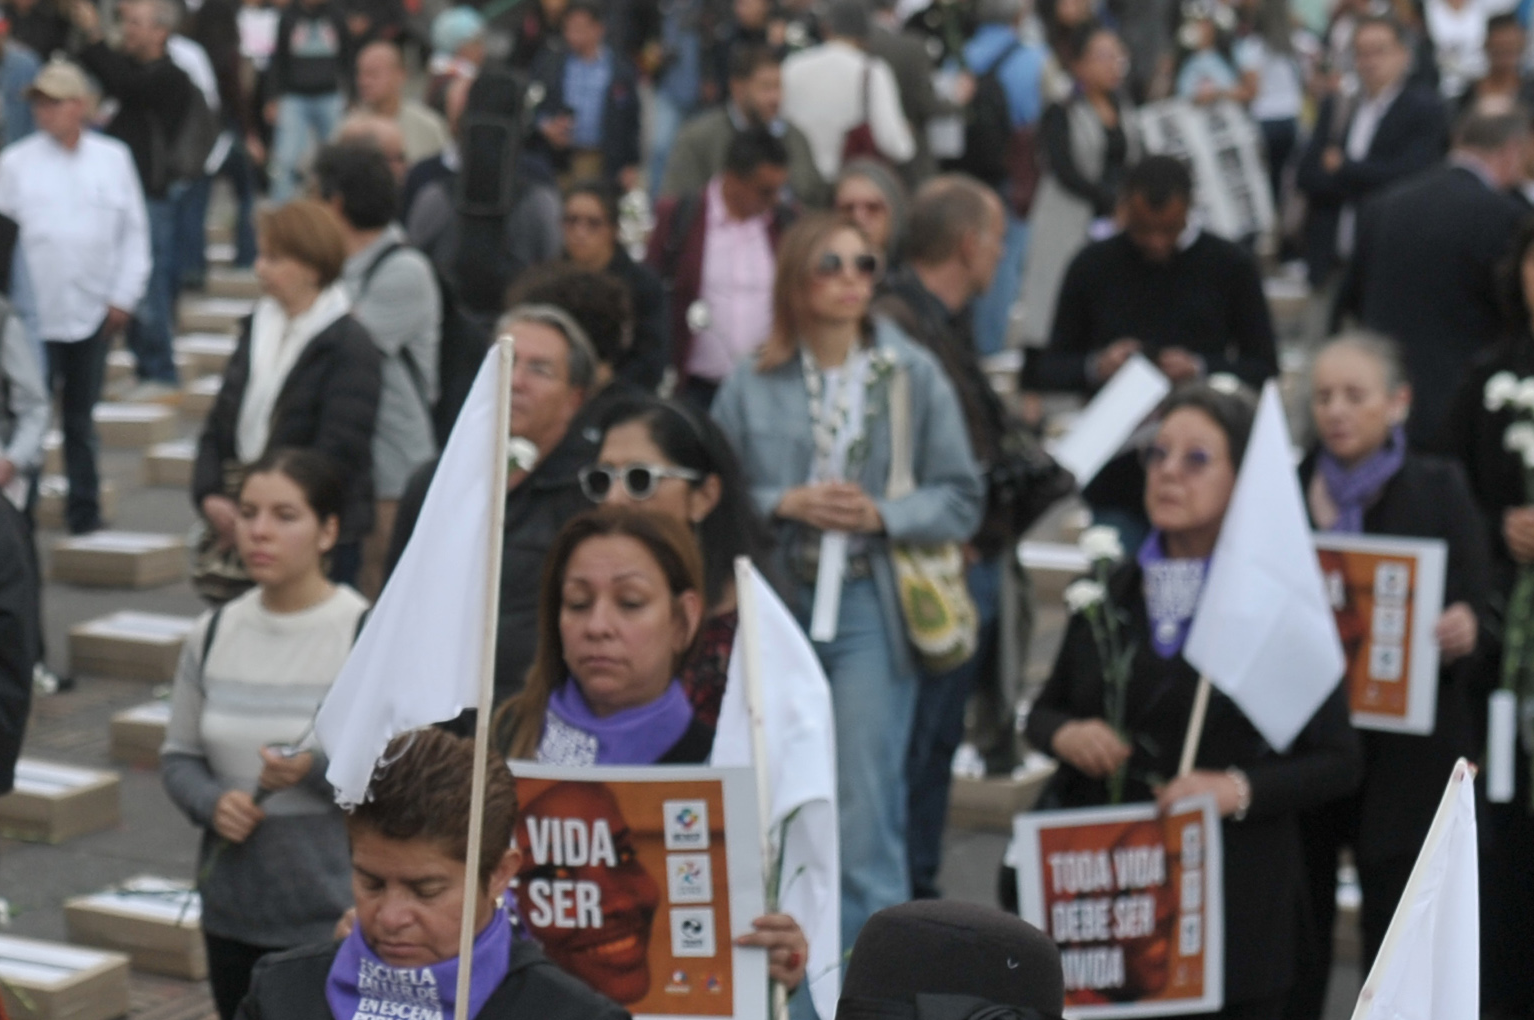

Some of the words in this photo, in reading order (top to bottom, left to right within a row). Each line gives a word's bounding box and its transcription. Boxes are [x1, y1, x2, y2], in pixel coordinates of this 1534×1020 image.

[526, 817, 617, 867] VIDA
[1049, 851, 1113, 894] TODA
[1113, 846, 1165, 890] VIDA
[528, 879, 604, 929] SER
[1051, 898, 1112, 943] DEBE
[1113, 894, 1156, 939] SER
[360, 959, 436, 985] ESCUELA
[358, 997, 380, 1014] EN
